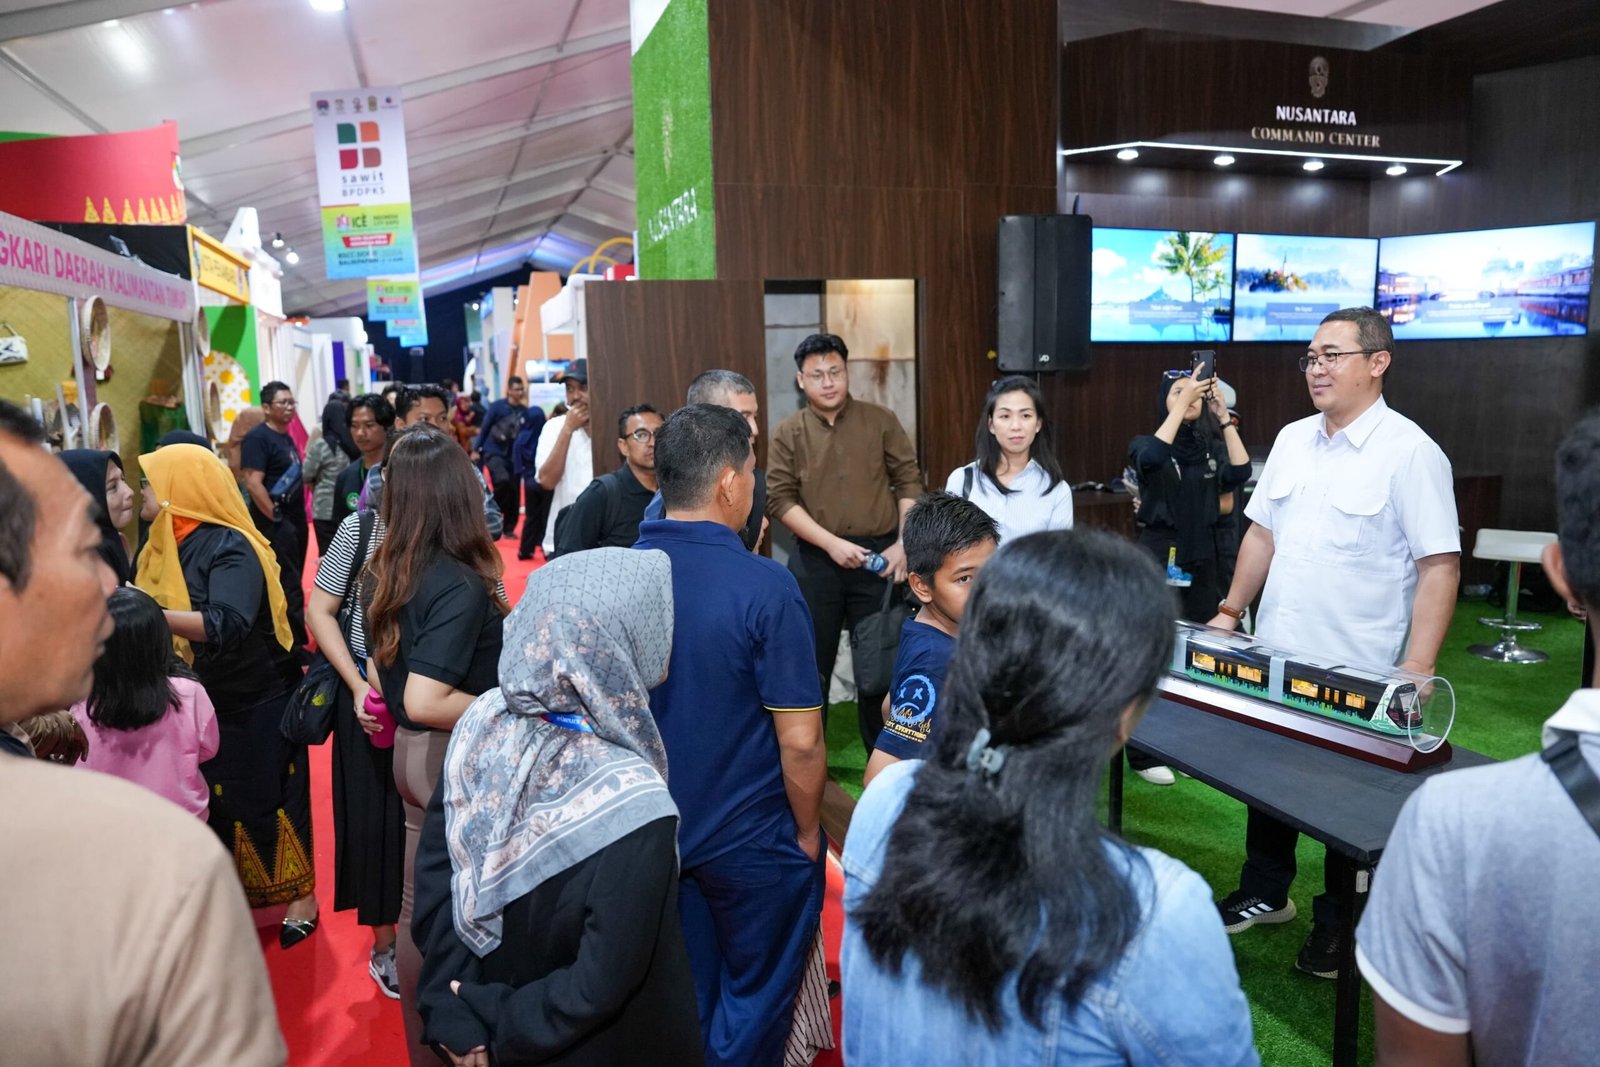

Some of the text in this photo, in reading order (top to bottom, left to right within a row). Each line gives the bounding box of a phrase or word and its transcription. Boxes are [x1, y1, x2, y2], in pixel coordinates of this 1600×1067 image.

[1276, 105, 1357, 126] NUSANTARA
[1251, 126, 1381, 148] COMMAND CENTER
[341, 172, 384, 184] sawit
[54, 247, 106, 291] DAERAH
